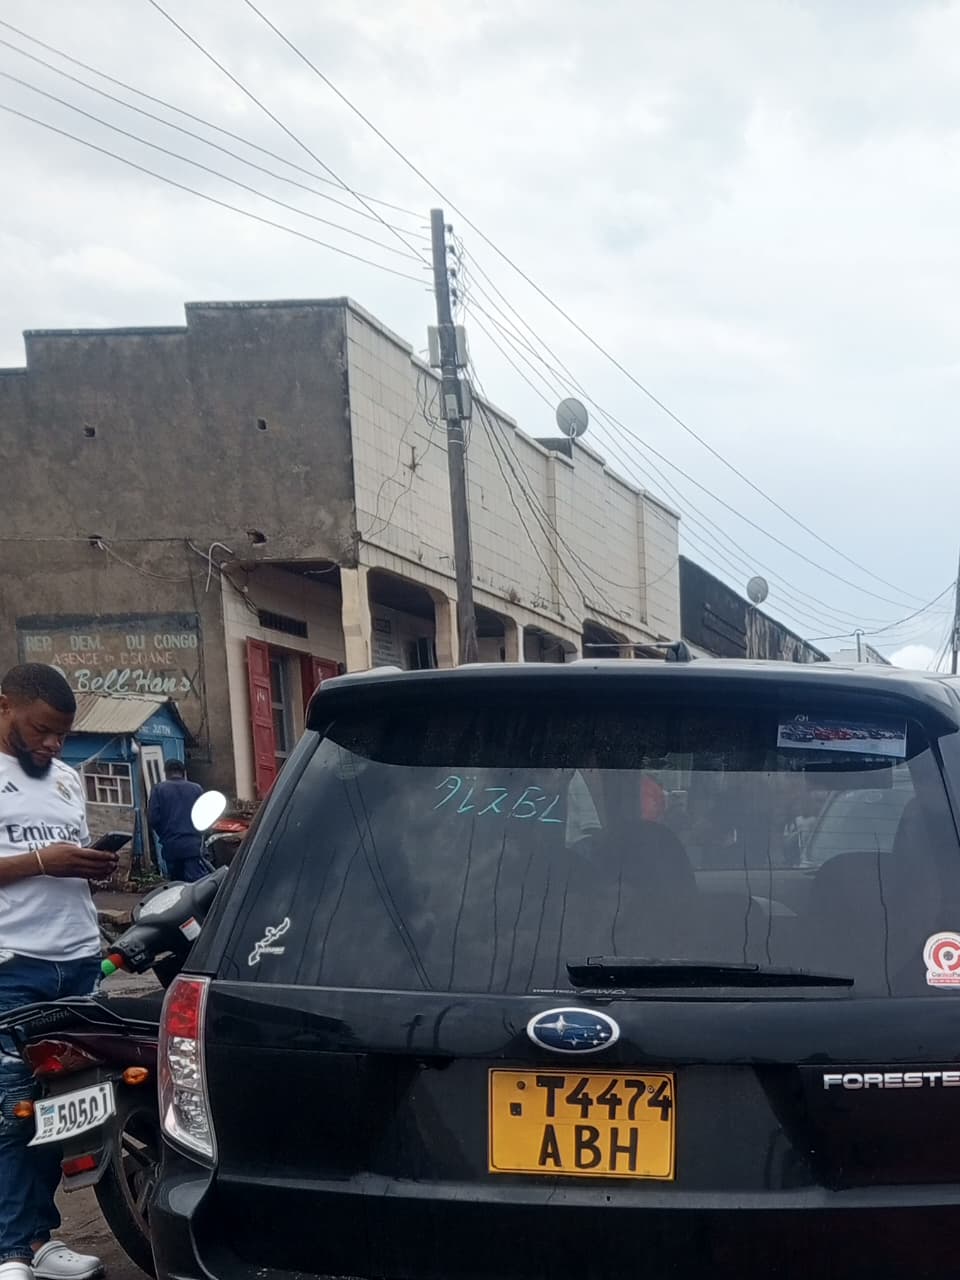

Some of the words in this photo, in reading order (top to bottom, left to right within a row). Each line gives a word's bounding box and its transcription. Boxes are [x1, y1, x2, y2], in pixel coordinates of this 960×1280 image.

[126, 634, 145, 650] DU
[154, 633, 198, 649] CONGO
[75, 668, 130, 692] Bell
[535, 1075, 673, 1121] T4474
[538, 1124, 639, 1172] ABH
